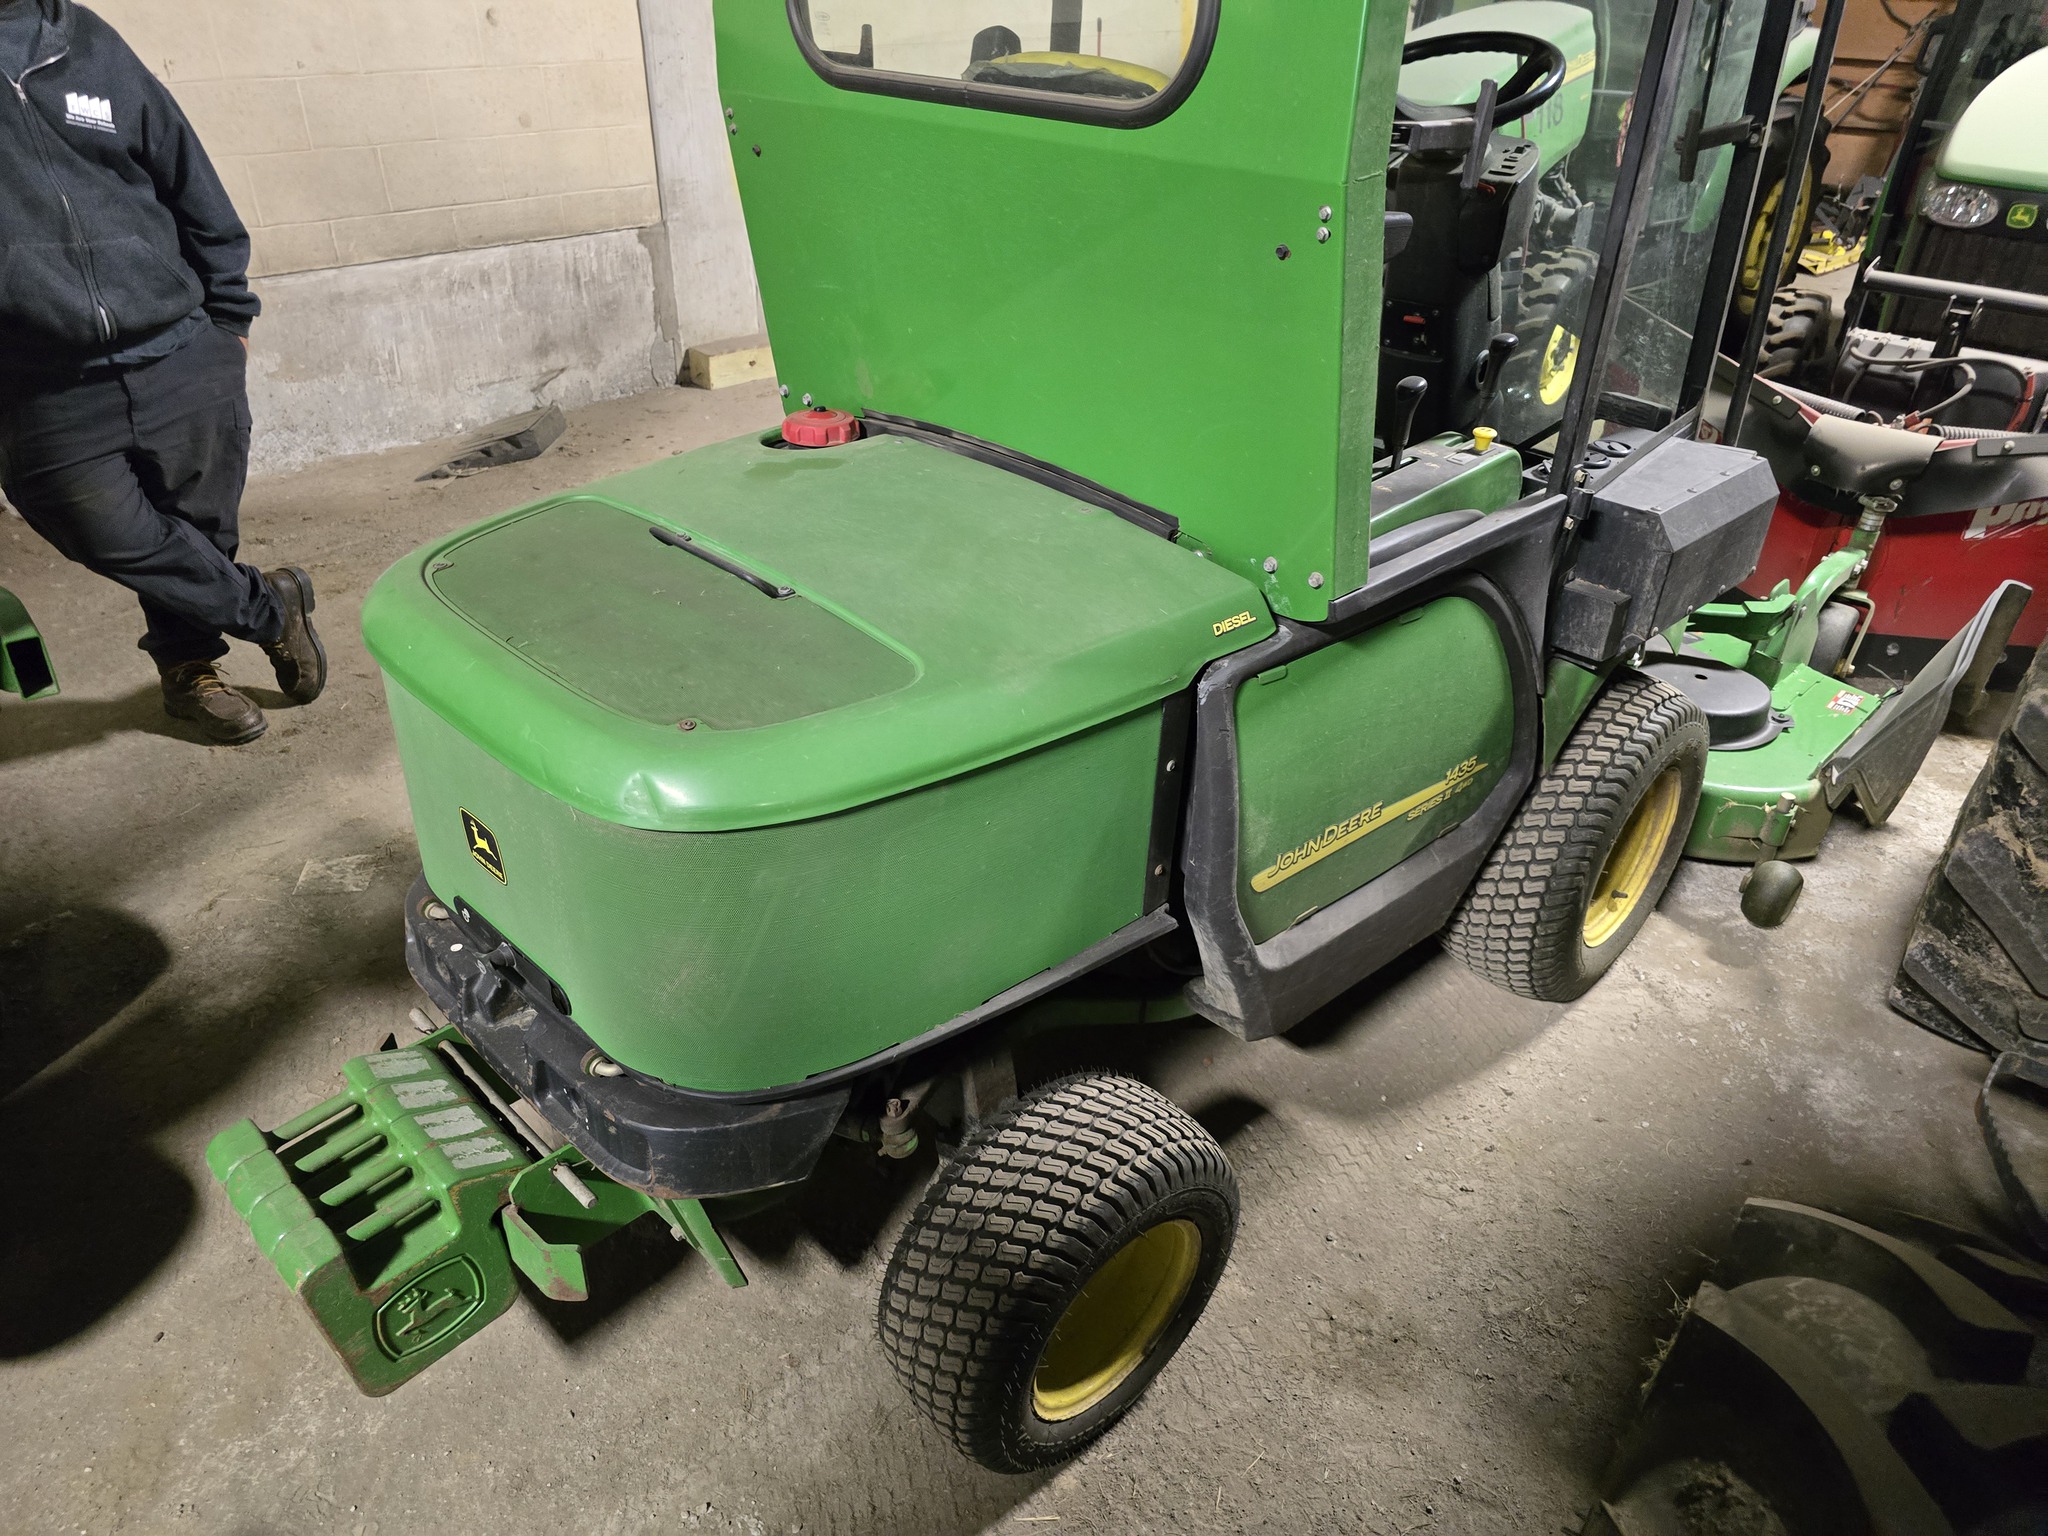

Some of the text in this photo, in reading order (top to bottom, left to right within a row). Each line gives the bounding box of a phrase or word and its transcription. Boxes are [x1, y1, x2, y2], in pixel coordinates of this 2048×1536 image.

[1212, 610, 1257, 637] DIESEL
[1445, 755, 1478, 786] 1435
[1406, 794, 1444, 821] SERIES
[1267, 799, 1384, 878] JOHN DEERE
